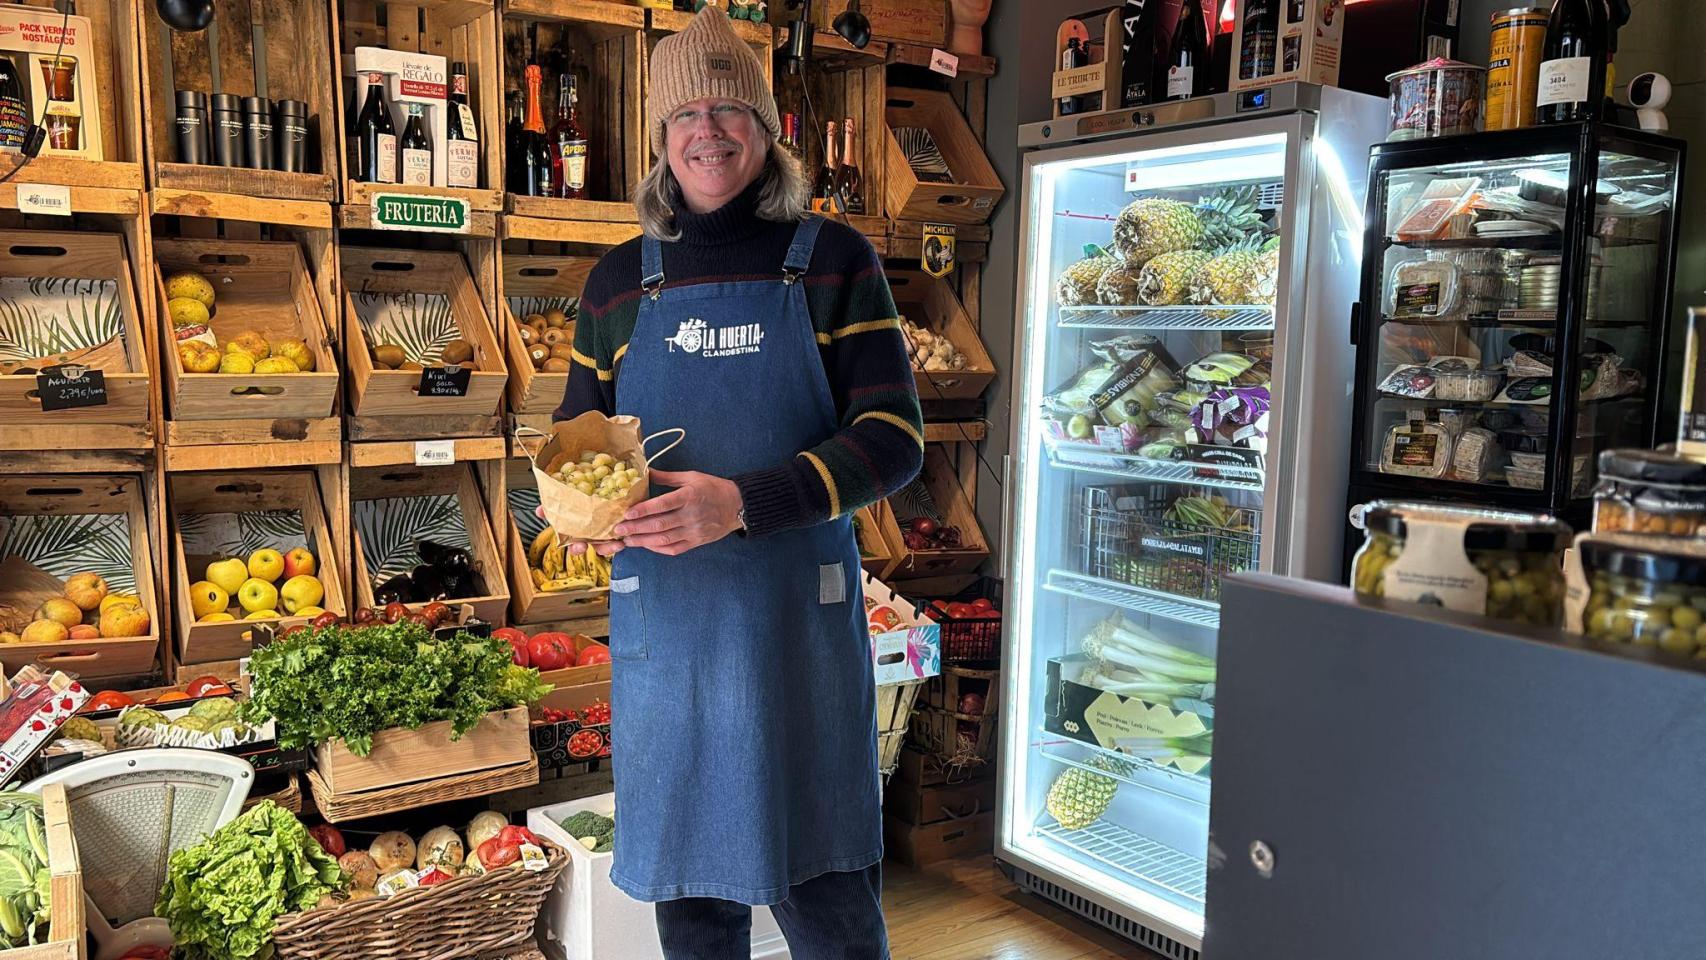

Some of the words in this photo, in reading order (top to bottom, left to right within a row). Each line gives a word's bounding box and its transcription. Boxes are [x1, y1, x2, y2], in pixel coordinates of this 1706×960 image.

[19, 22, 41, 32] PACK
[22, 33, 75, 46] NOSTÁLGCO
[711, 58, 731, 71] UGG
[402, 69, 443, 83] REGALO
[384, 201, 459, 225] FRUTERÍA
[925, 224, 956, 235] MICHELIN
[702, 328, 716, 350] LA
[719, 323, 760, 349] HUERTA
[702, 345, 760, 357] CLANDESTINA
[1107, 366, 1146, 397] ENDIBIAS
